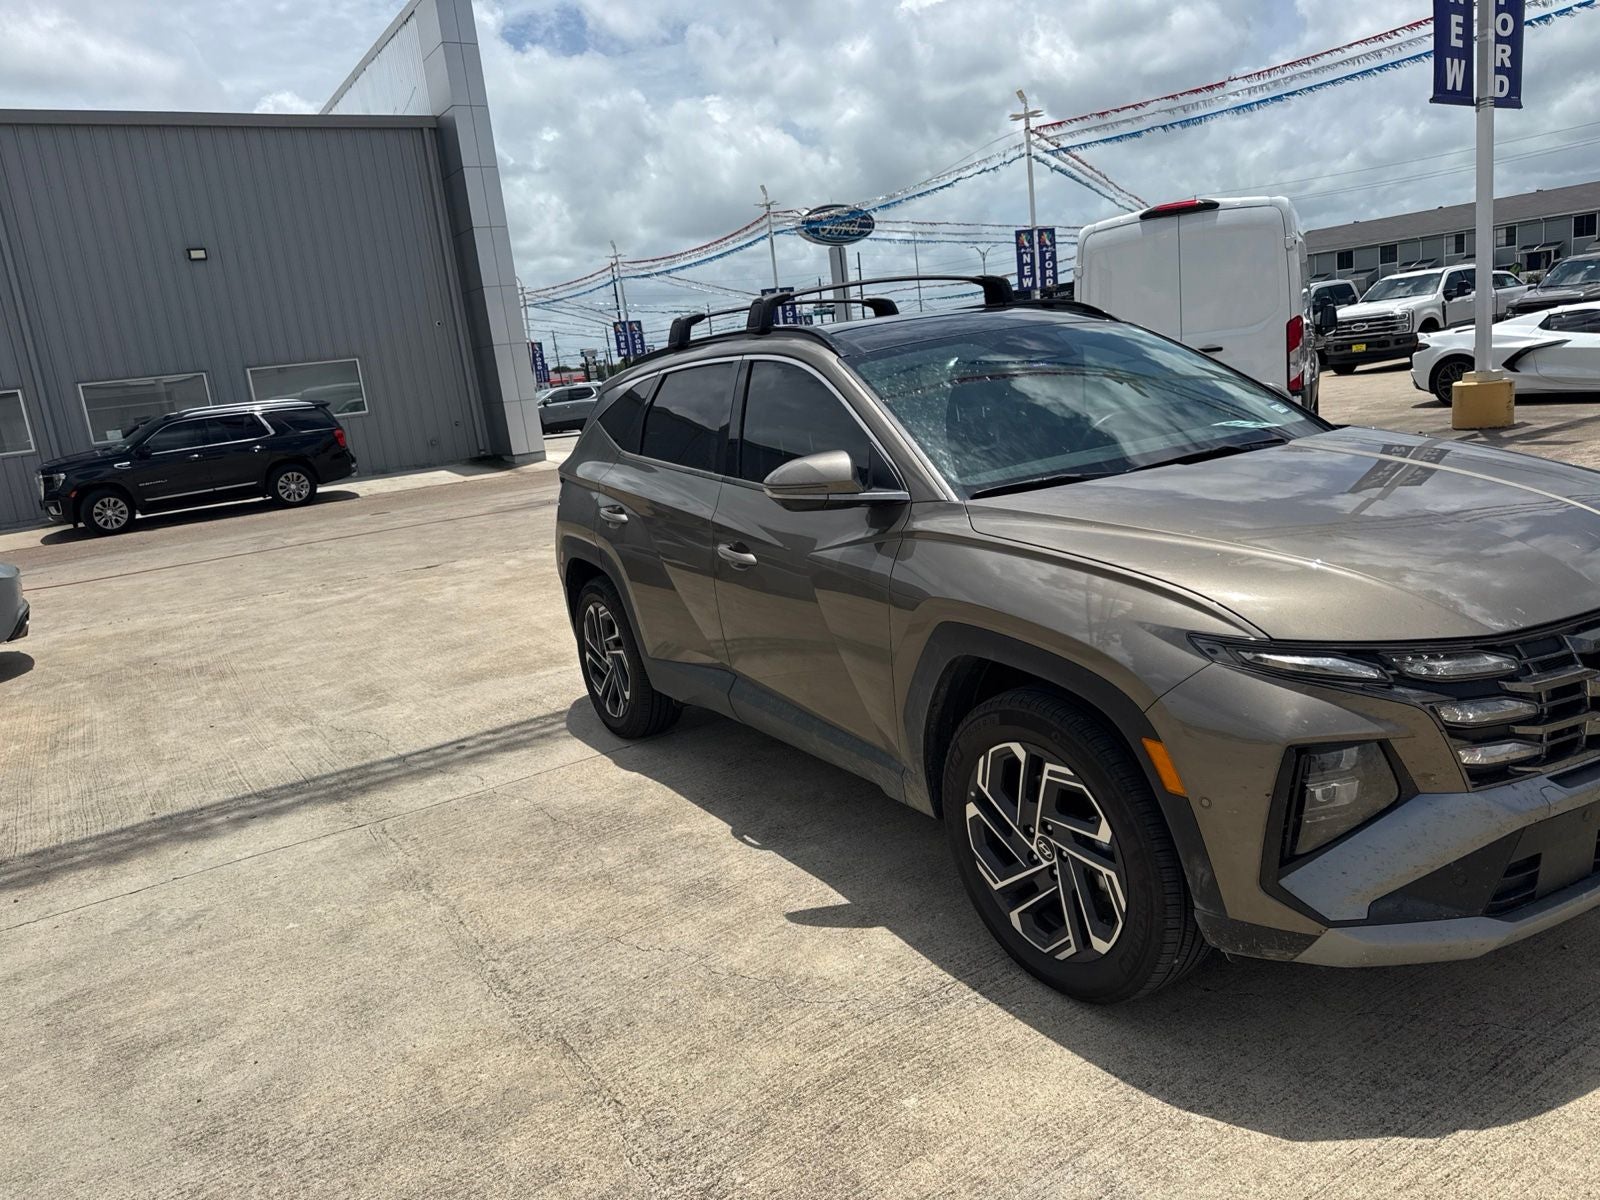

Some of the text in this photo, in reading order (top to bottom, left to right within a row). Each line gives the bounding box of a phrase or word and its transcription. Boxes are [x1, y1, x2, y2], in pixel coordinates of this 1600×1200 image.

[1446, 0, 1466, 92] EW
[1494, 0, 1515, 98] ORD
[1022, 253, 1033, 288] NEW
[1045, 252, 1054, 286] FORD
[619, 335, 628, 356] NEW
[634, 334, 642, 354] FORD
